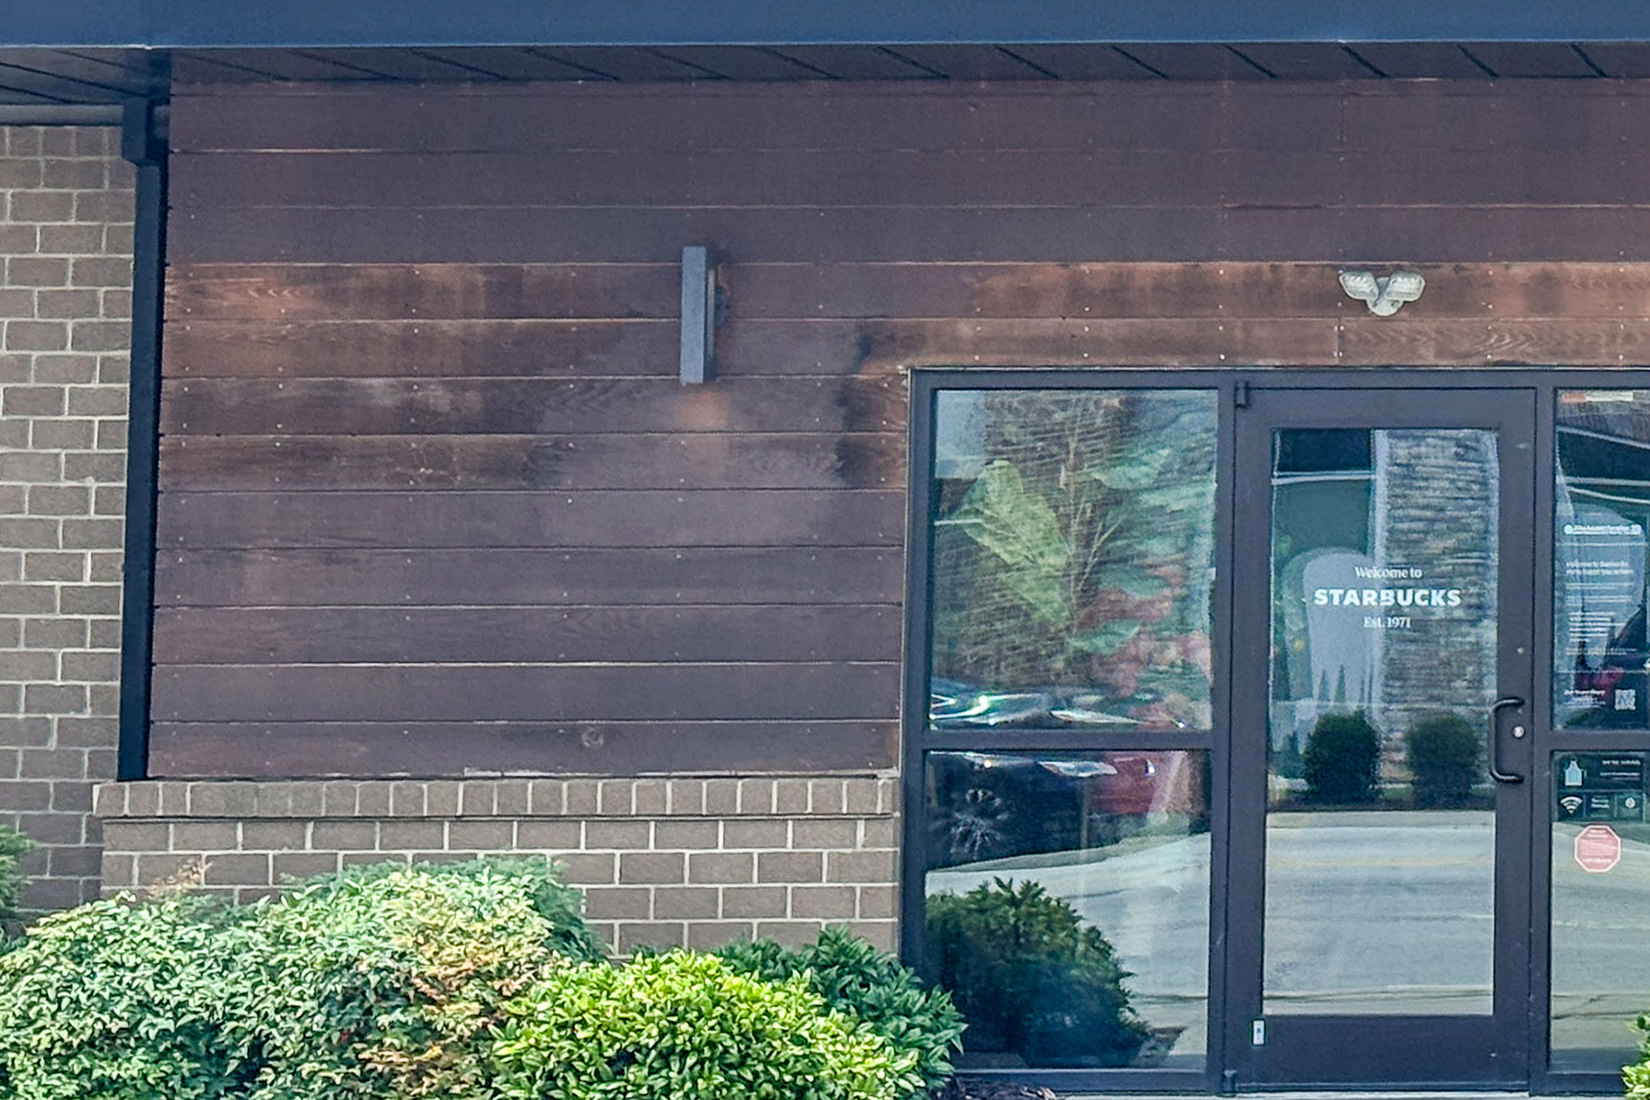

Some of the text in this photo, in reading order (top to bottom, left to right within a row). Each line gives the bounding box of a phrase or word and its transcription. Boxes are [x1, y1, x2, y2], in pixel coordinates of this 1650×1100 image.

[1354, 566, 1423, 578] Welcome to
[1314, 588, 1462, 606] STARBUCKS
[1363, 616, 1411, 628] Est. 1971
